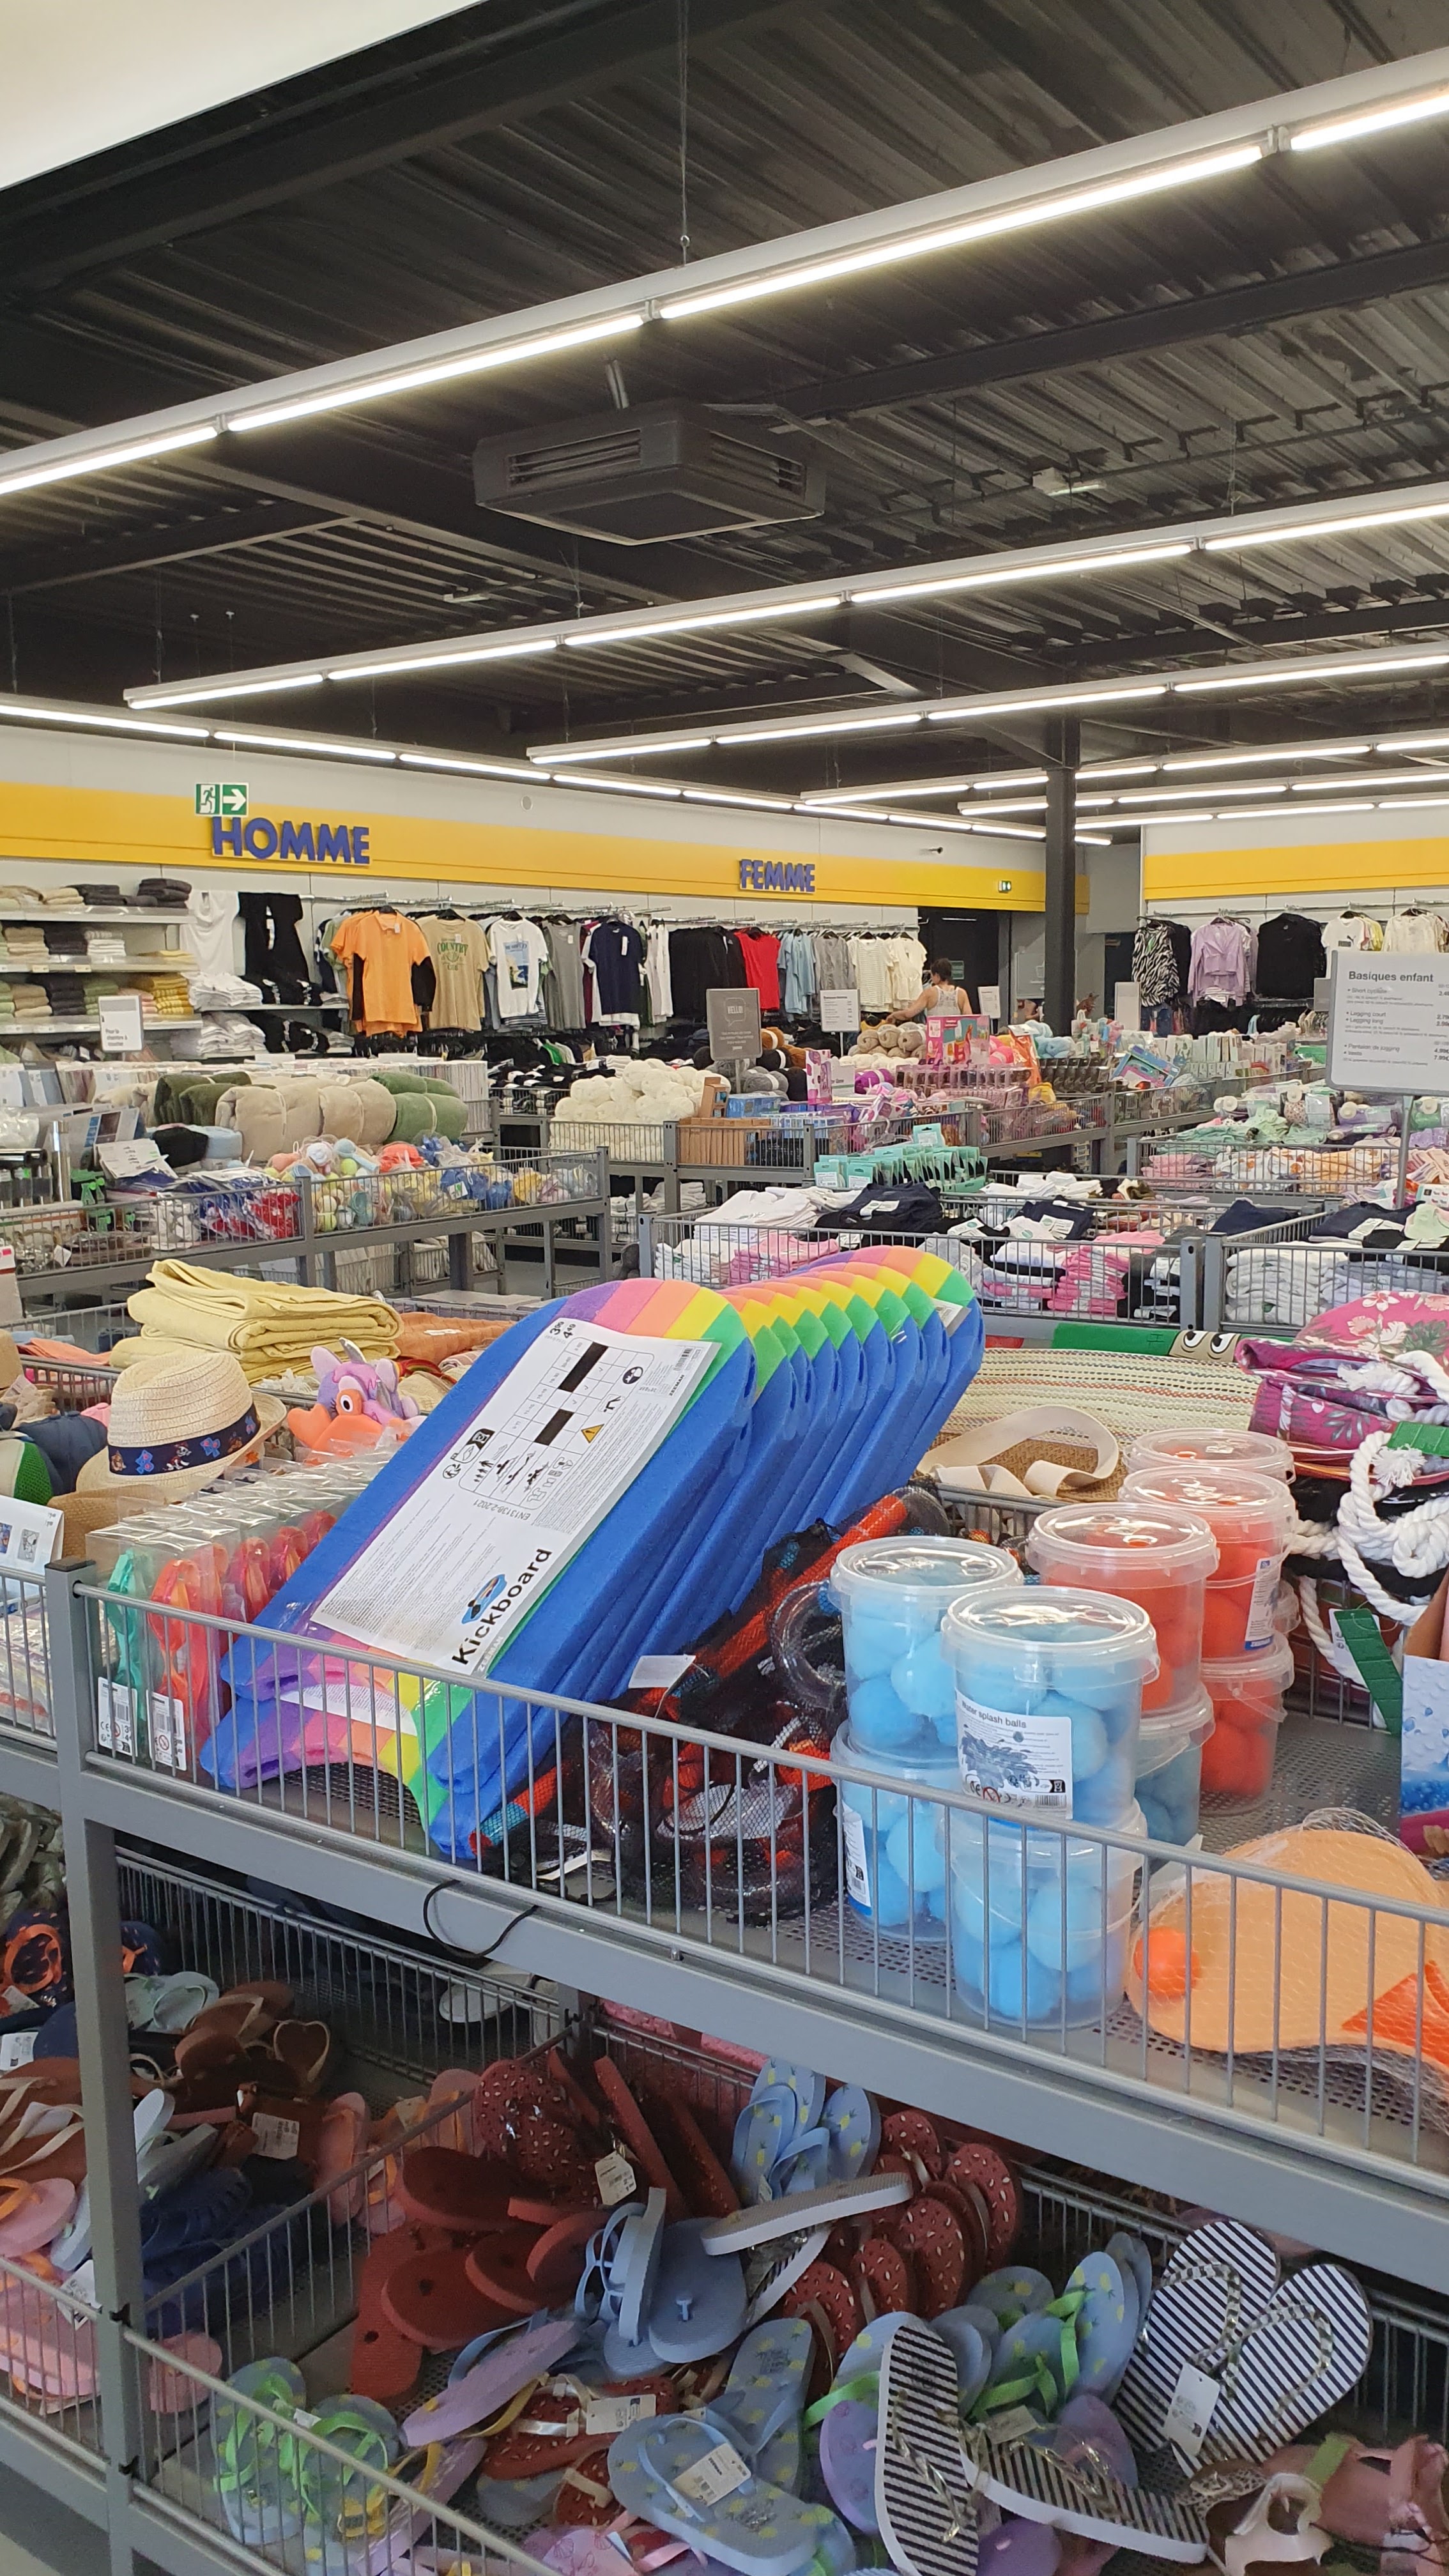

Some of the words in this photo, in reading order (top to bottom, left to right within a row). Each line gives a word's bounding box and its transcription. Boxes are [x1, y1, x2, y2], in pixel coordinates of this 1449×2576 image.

[212, 816, 371, 864] HOMME
[740, 859, 815, 893] FEMME
[437, 941, 469, 956] COUNTRY
[1348, 970, 1397, 982] Basiques
[1400, 972, 1434, 982] enfant
[668, 1374, 686, 1397] ZEEMAN
[451, 1548, 553, 1666] Kickboard
[962, 1700, 977, 1715] Water
[978, 1711, 1003, 1725] splash
[1005, 1717, 1027, 1729] balls
